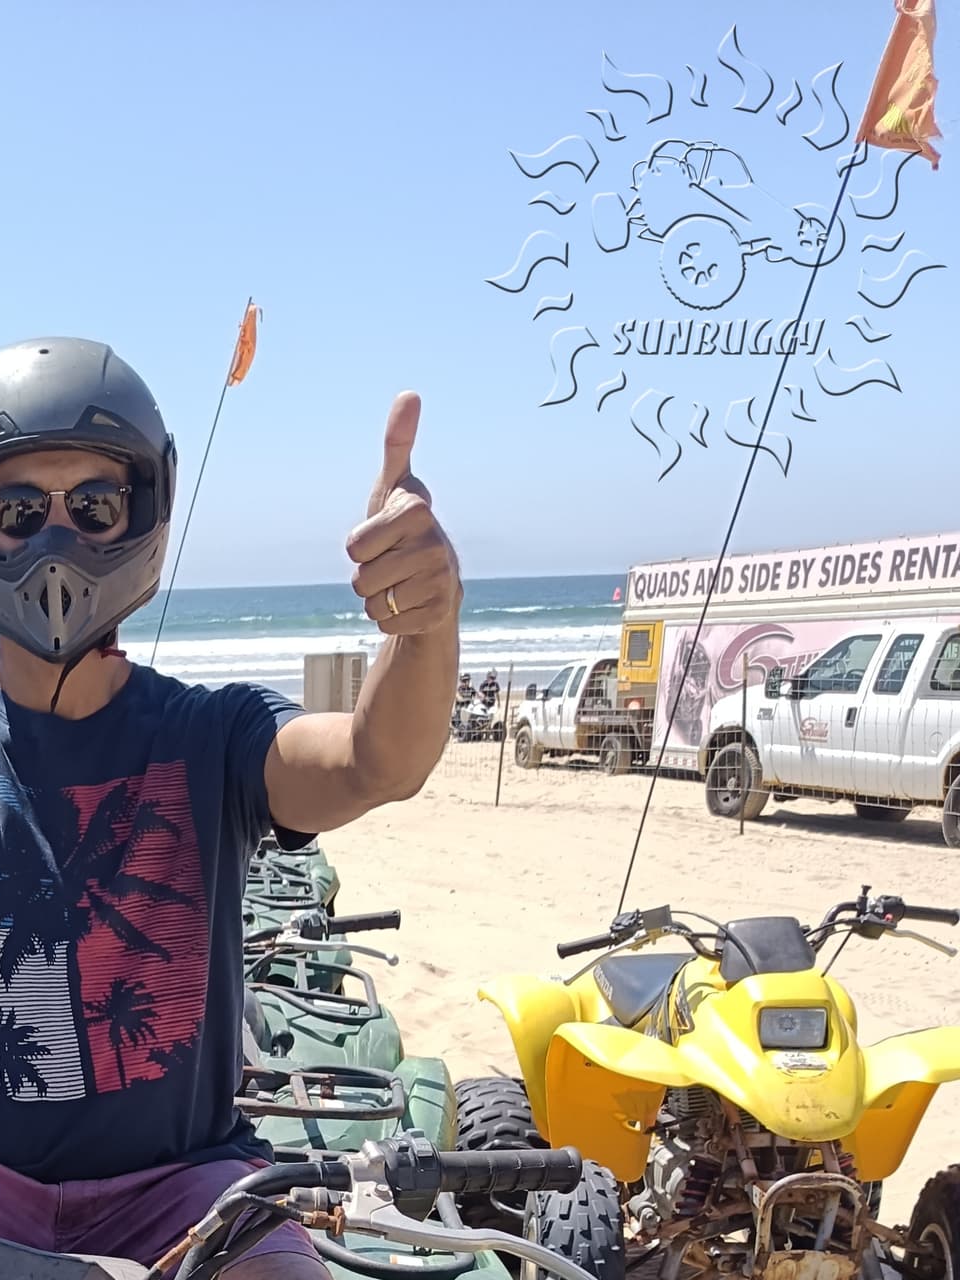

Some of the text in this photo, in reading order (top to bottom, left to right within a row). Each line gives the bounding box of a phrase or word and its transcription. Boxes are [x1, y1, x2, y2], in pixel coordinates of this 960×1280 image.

[634, 569, 690, 602] QUADS
[693, 565, 733, 596] AND
[738, 561, 783, 593] SIDE
[787, 557, 816, 589] BY
[818, 551, 883, 588] SIDES
